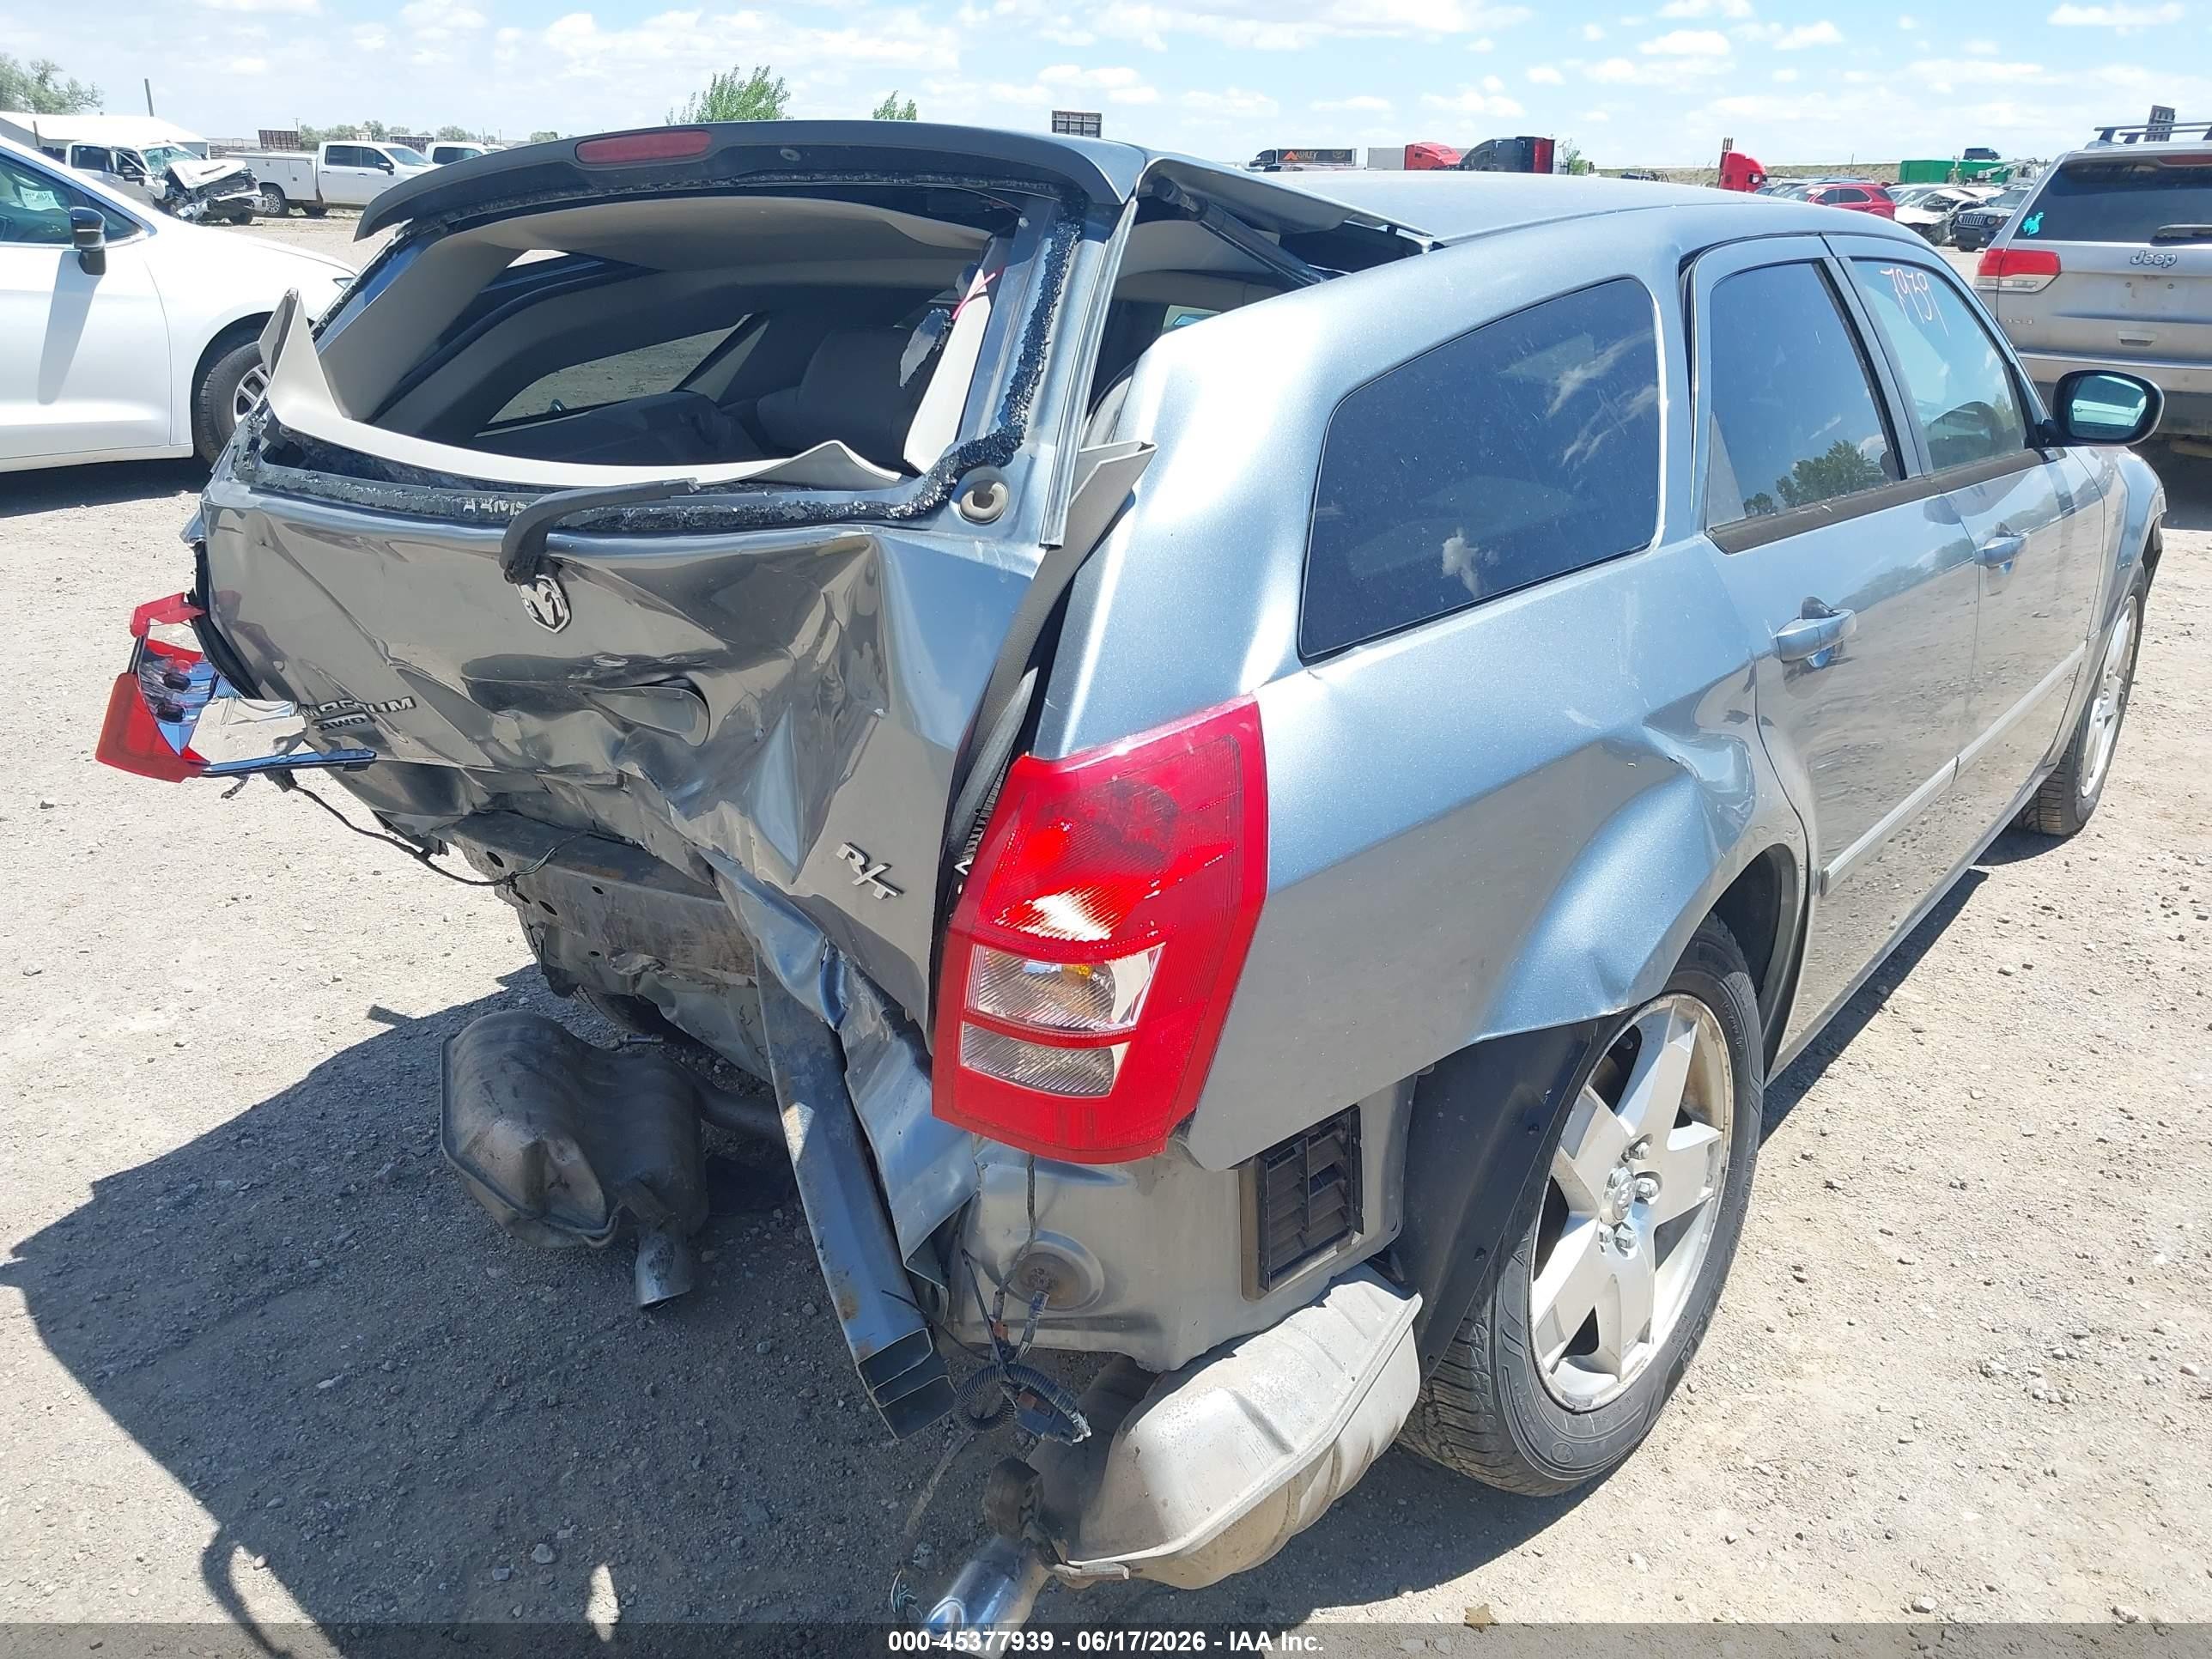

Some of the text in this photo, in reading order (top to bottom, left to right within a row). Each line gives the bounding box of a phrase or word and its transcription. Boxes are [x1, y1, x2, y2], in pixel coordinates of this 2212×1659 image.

[2130, 250, 2178, 269] Jeep
[318, 714, 367, 731] AWD
[836, 842, 904, 900] R/T
